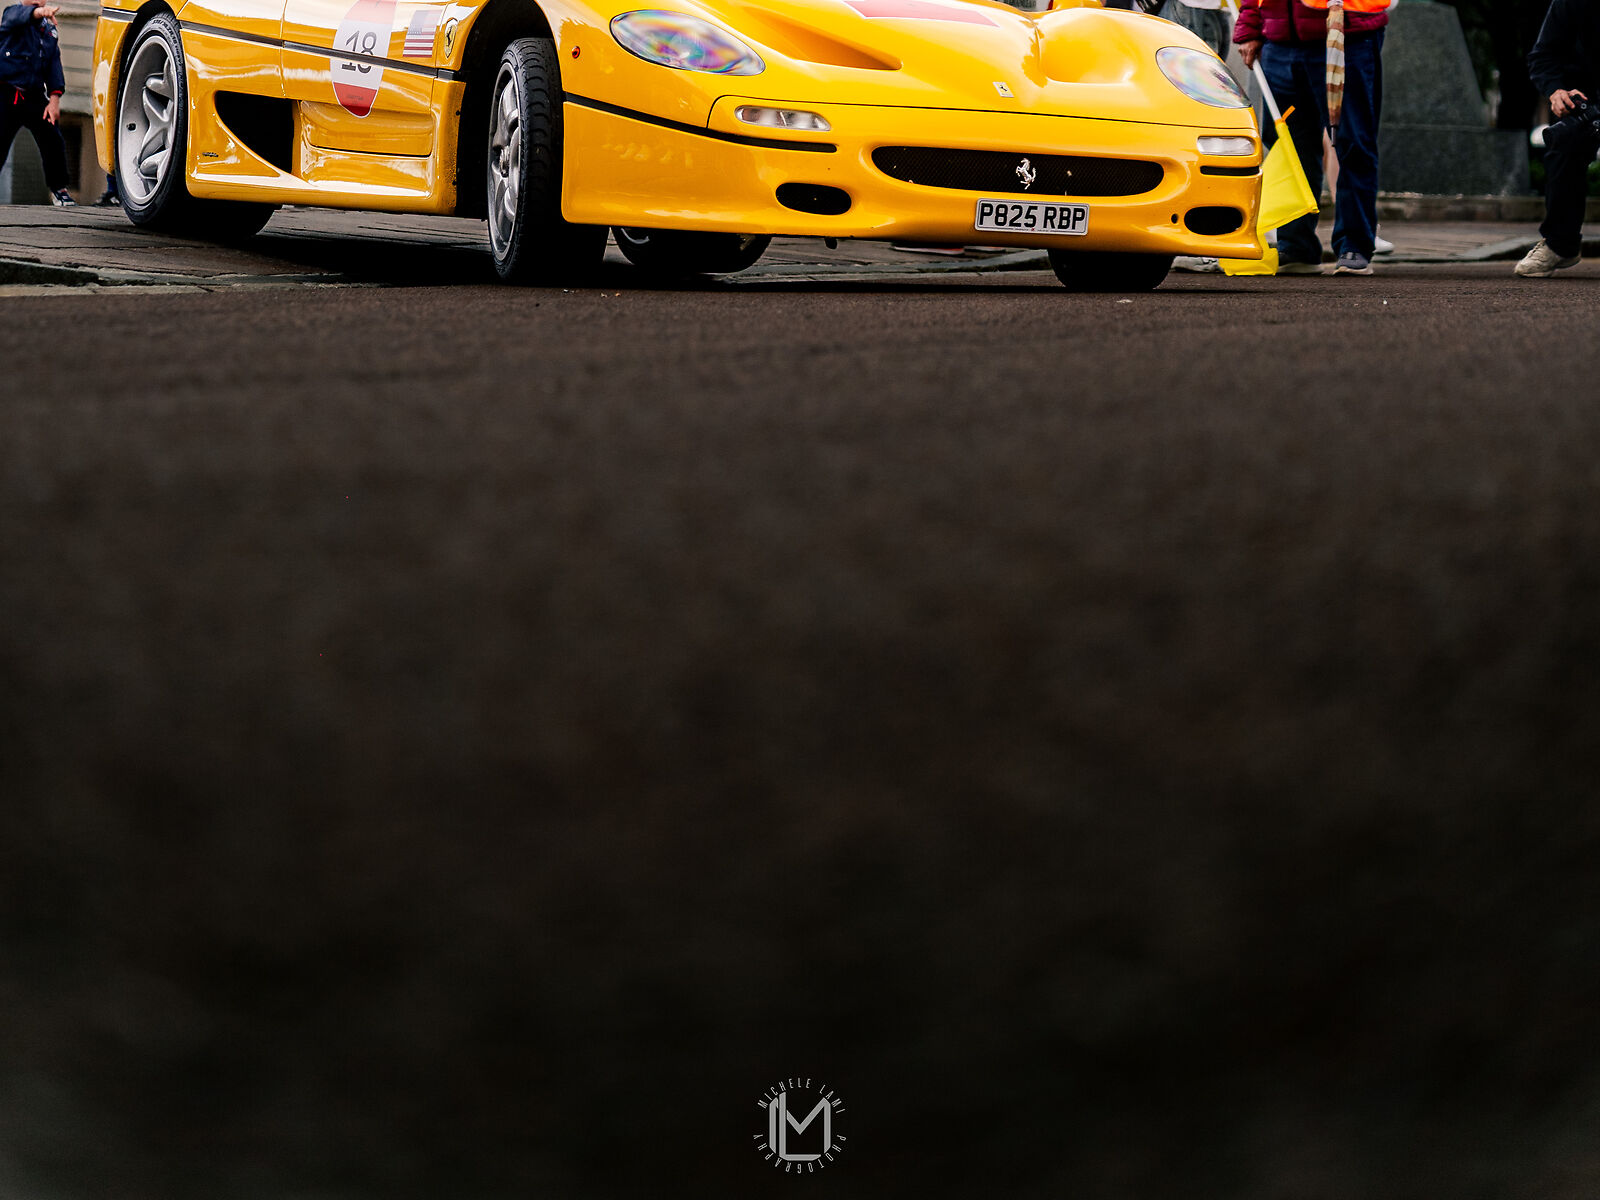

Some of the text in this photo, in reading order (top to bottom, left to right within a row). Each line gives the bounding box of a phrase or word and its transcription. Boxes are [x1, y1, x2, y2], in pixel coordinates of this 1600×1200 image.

[342, 31, 377, 73] 18
[979, 202, 1086, 230] P825 RBP
